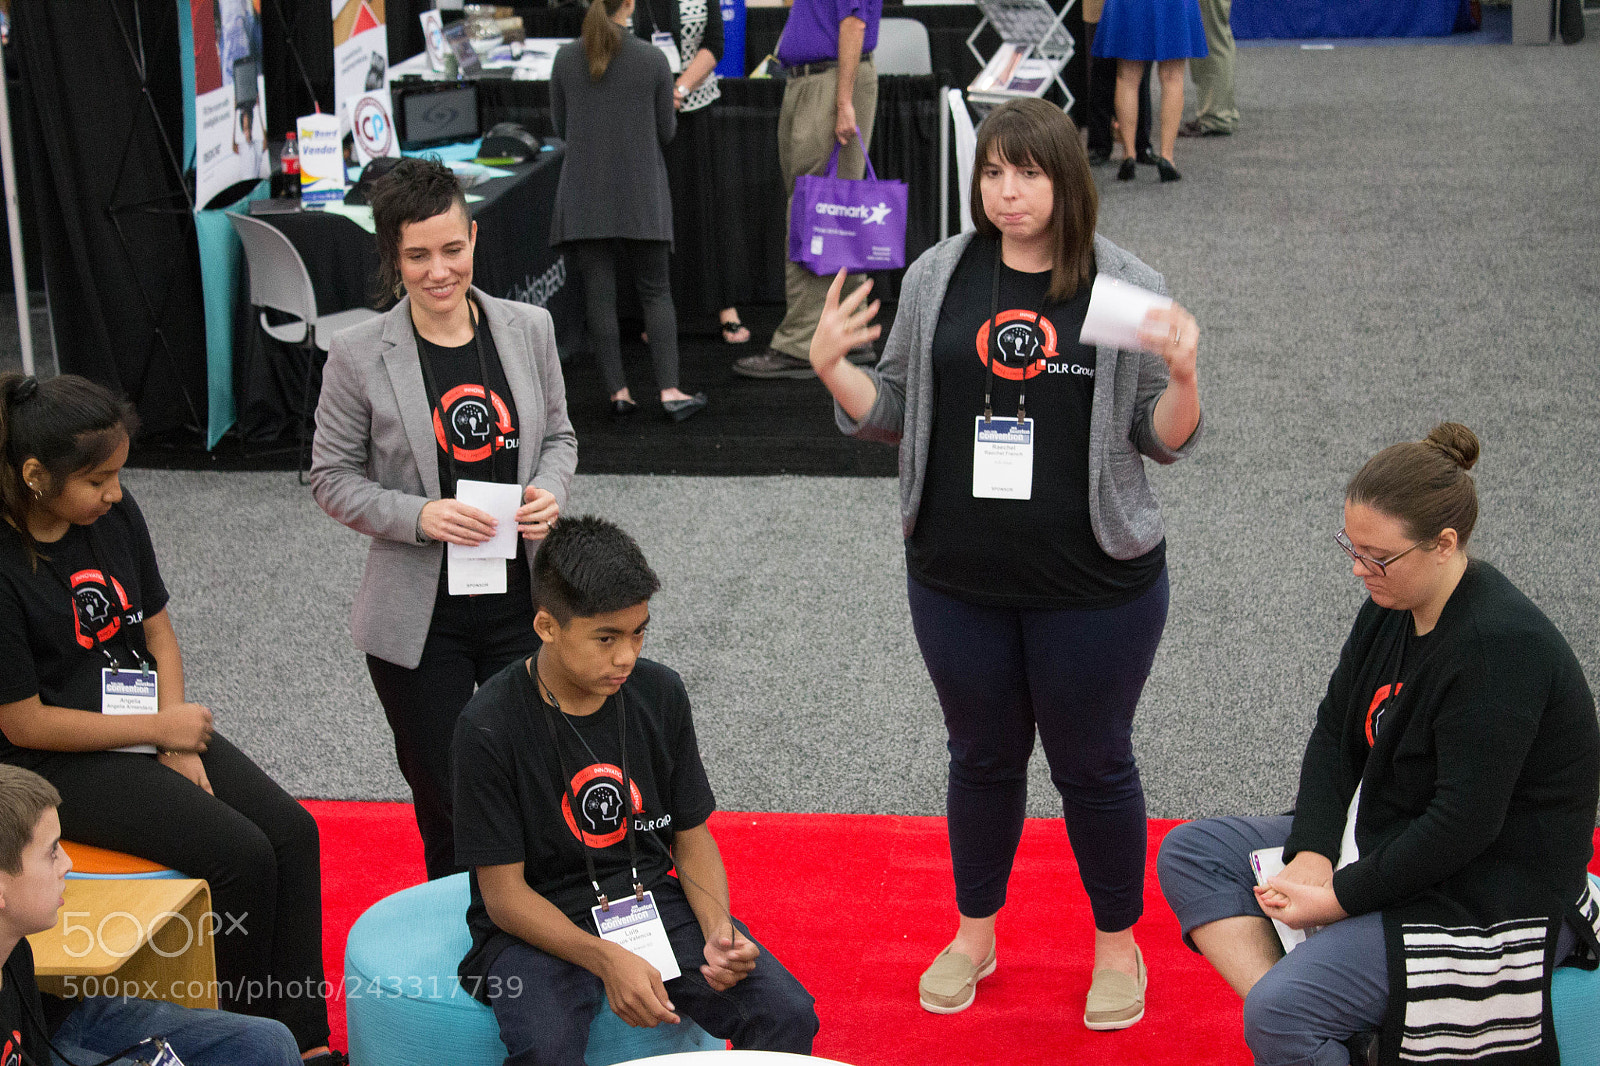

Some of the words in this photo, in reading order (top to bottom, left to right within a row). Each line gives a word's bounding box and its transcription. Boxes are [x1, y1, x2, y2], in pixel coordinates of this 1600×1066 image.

[302, 145, 337, 155] Vendor
[815, 202, 869, 219] aramark
[1047, 363, 1069, 374] DLR
[593, 767, 624, 780] INNOVATIO
[601, 911, 649, 930] convention
